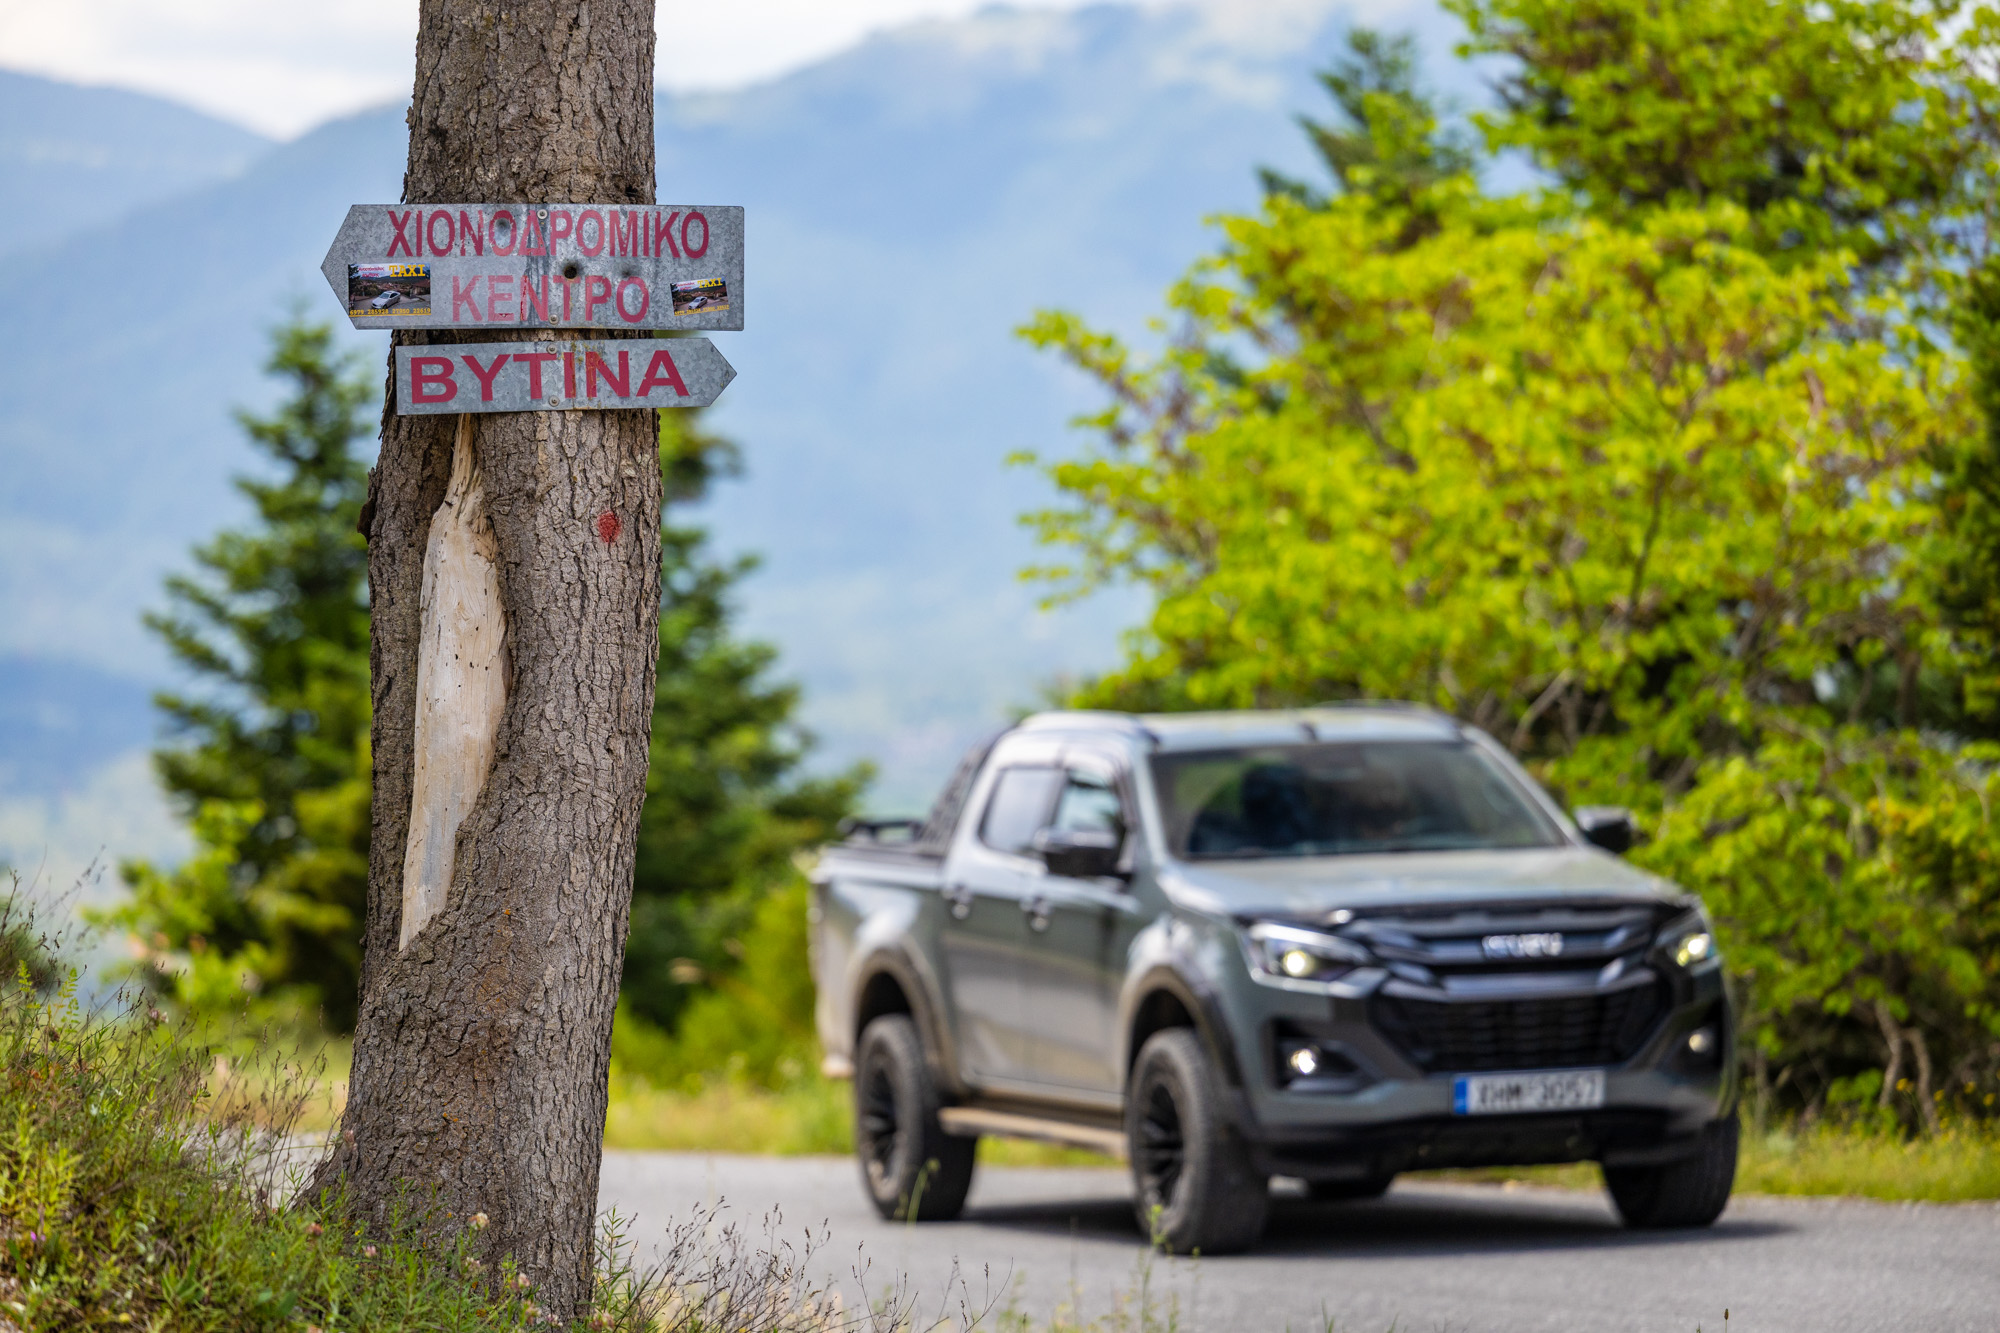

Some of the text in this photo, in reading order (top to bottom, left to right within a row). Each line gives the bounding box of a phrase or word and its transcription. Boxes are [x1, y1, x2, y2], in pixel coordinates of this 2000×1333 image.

[386, 209, 710, 259] ΧΙΟΝΟΔΡΟΜΙΚΟ
[389, 264, 426, 277] TAXI
[697, 277, 723, 288] TAXI
[452, 274, 650, 323] ΚΕΝΤΡΟ
[410, 350, 690, 404] ΒΥΤΙΝΑ
